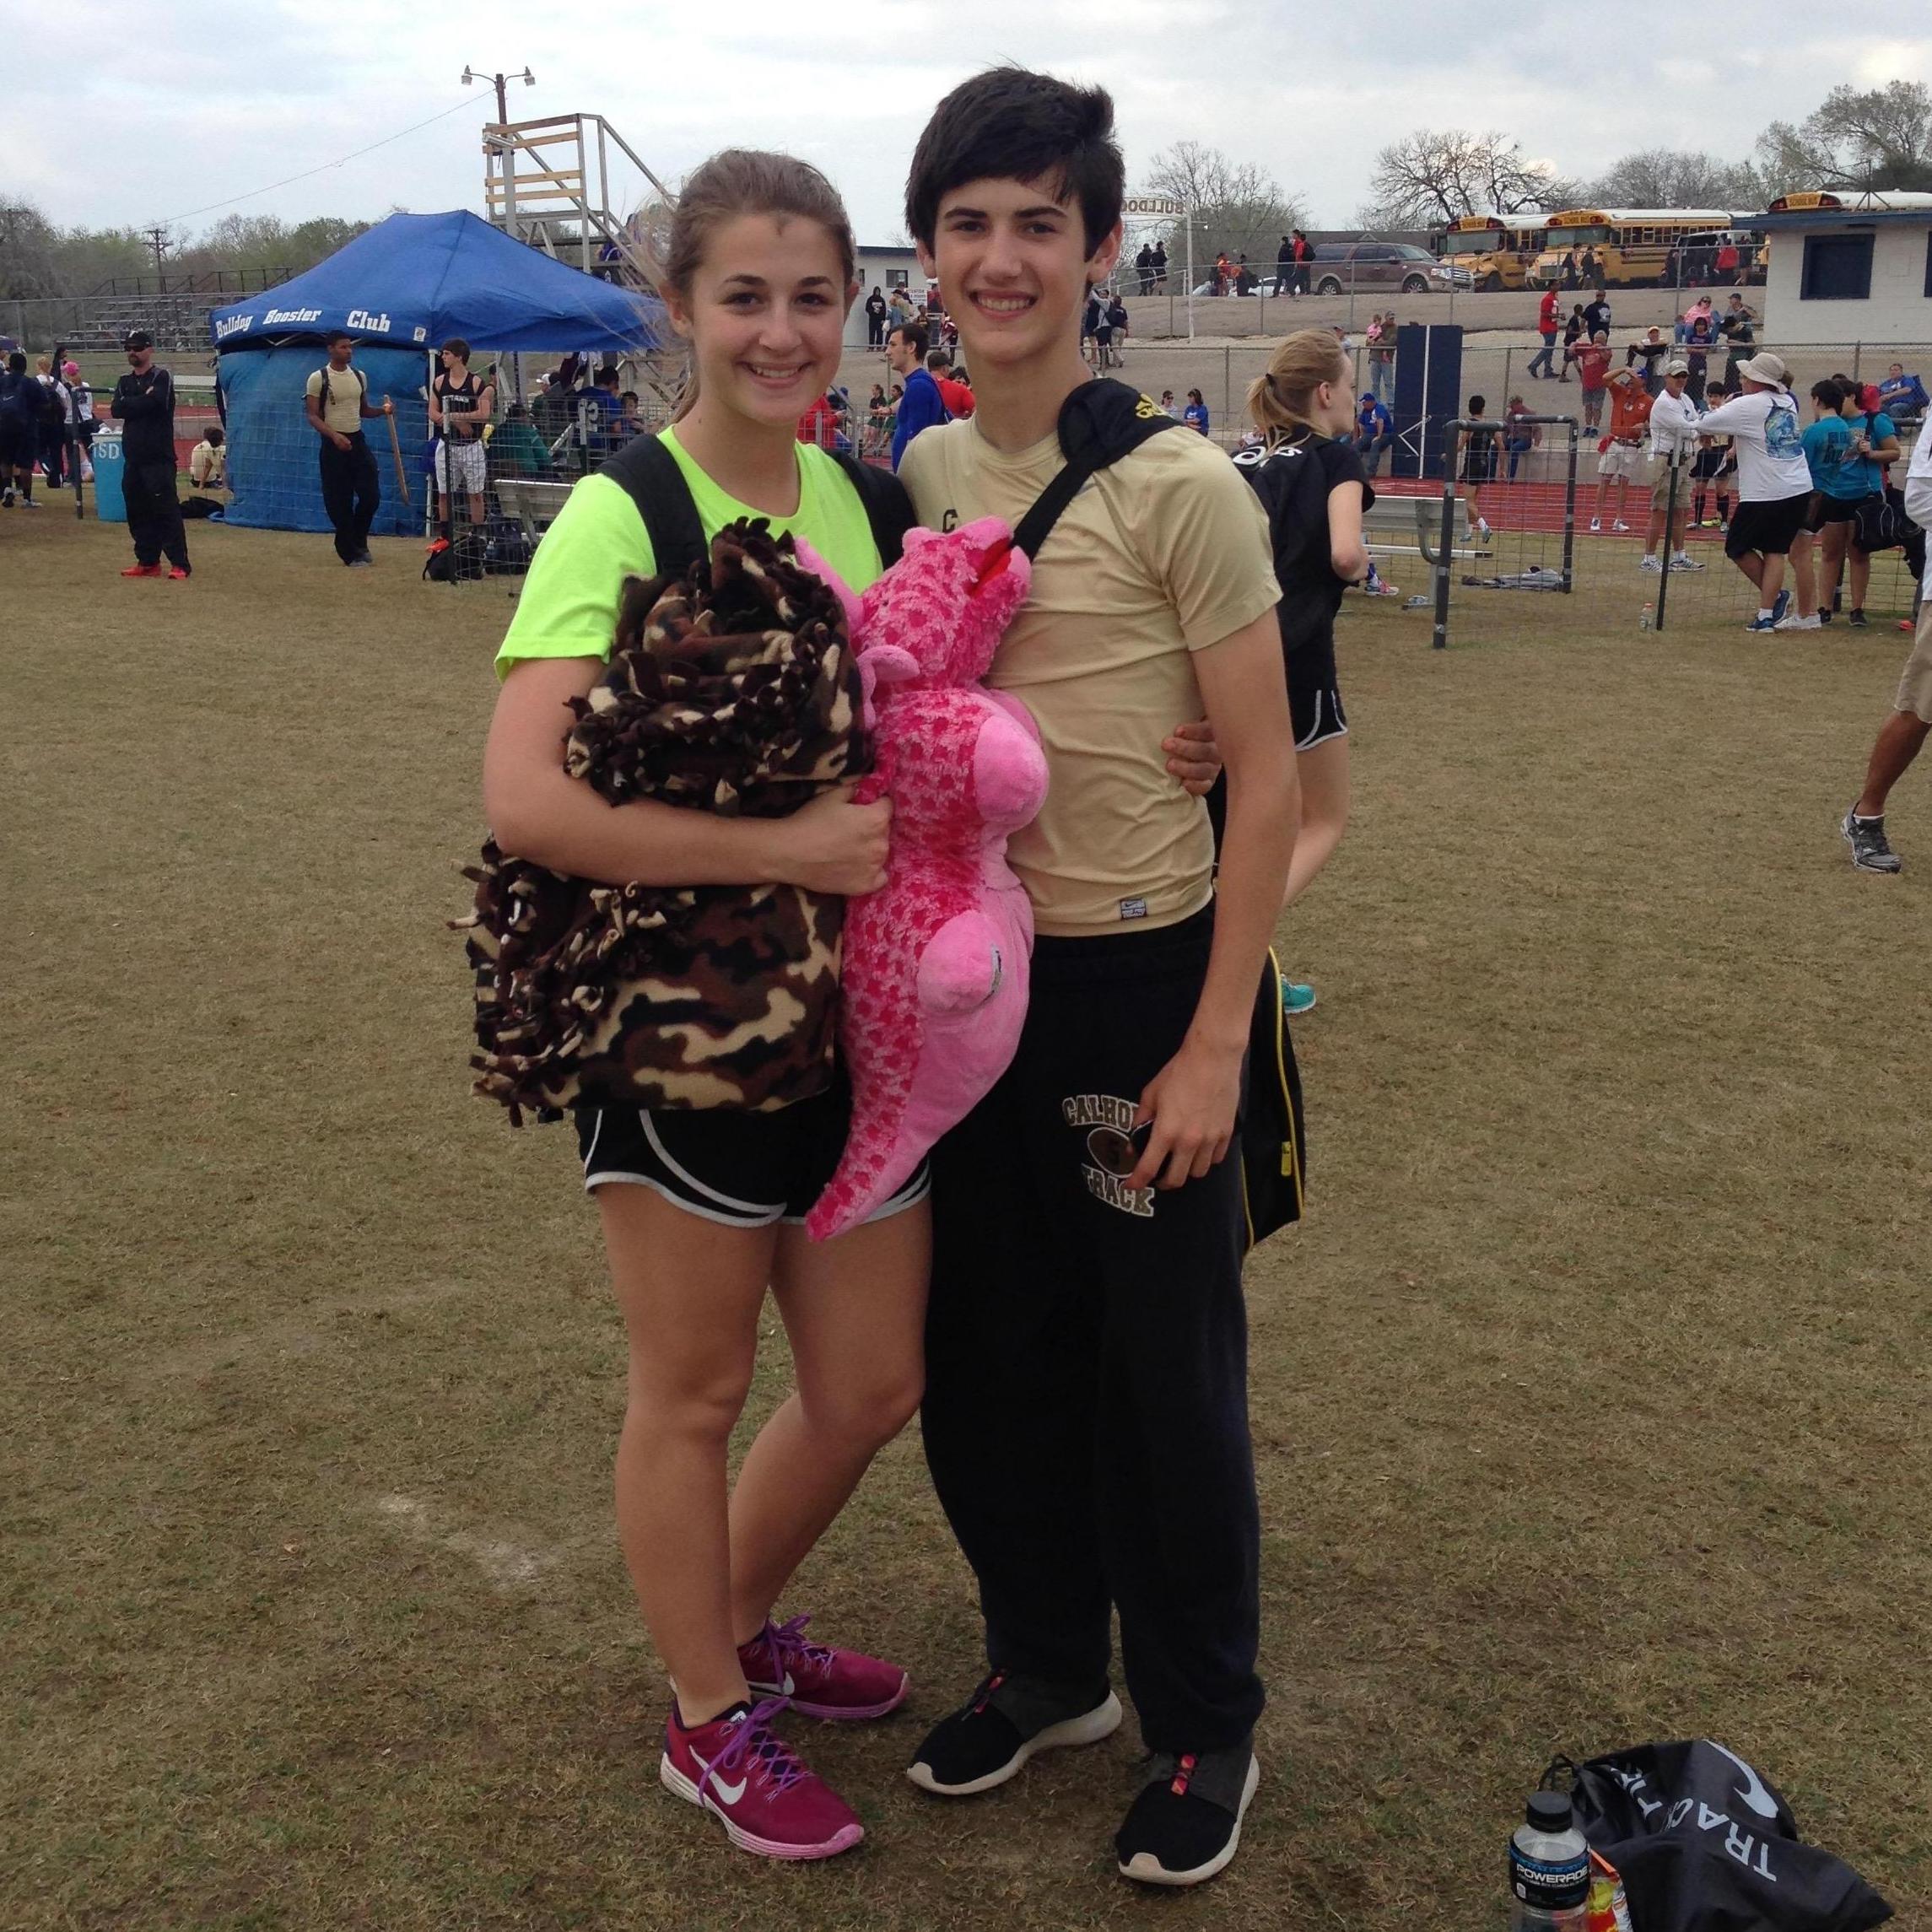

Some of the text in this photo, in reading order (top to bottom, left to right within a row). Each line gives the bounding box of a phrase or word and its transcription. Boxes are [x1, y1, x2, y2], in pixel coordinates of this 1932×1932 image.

[215, 308, 391, 338] Bulldog Booster Club
[1062, 1094, 1140, 1132] CALHO
[1081, 1163, 1154, 1217] TRACK
[1661, 1798, 1777, 1881] TRAC
[1516, 1862, 1588, 1883] POWERADE
